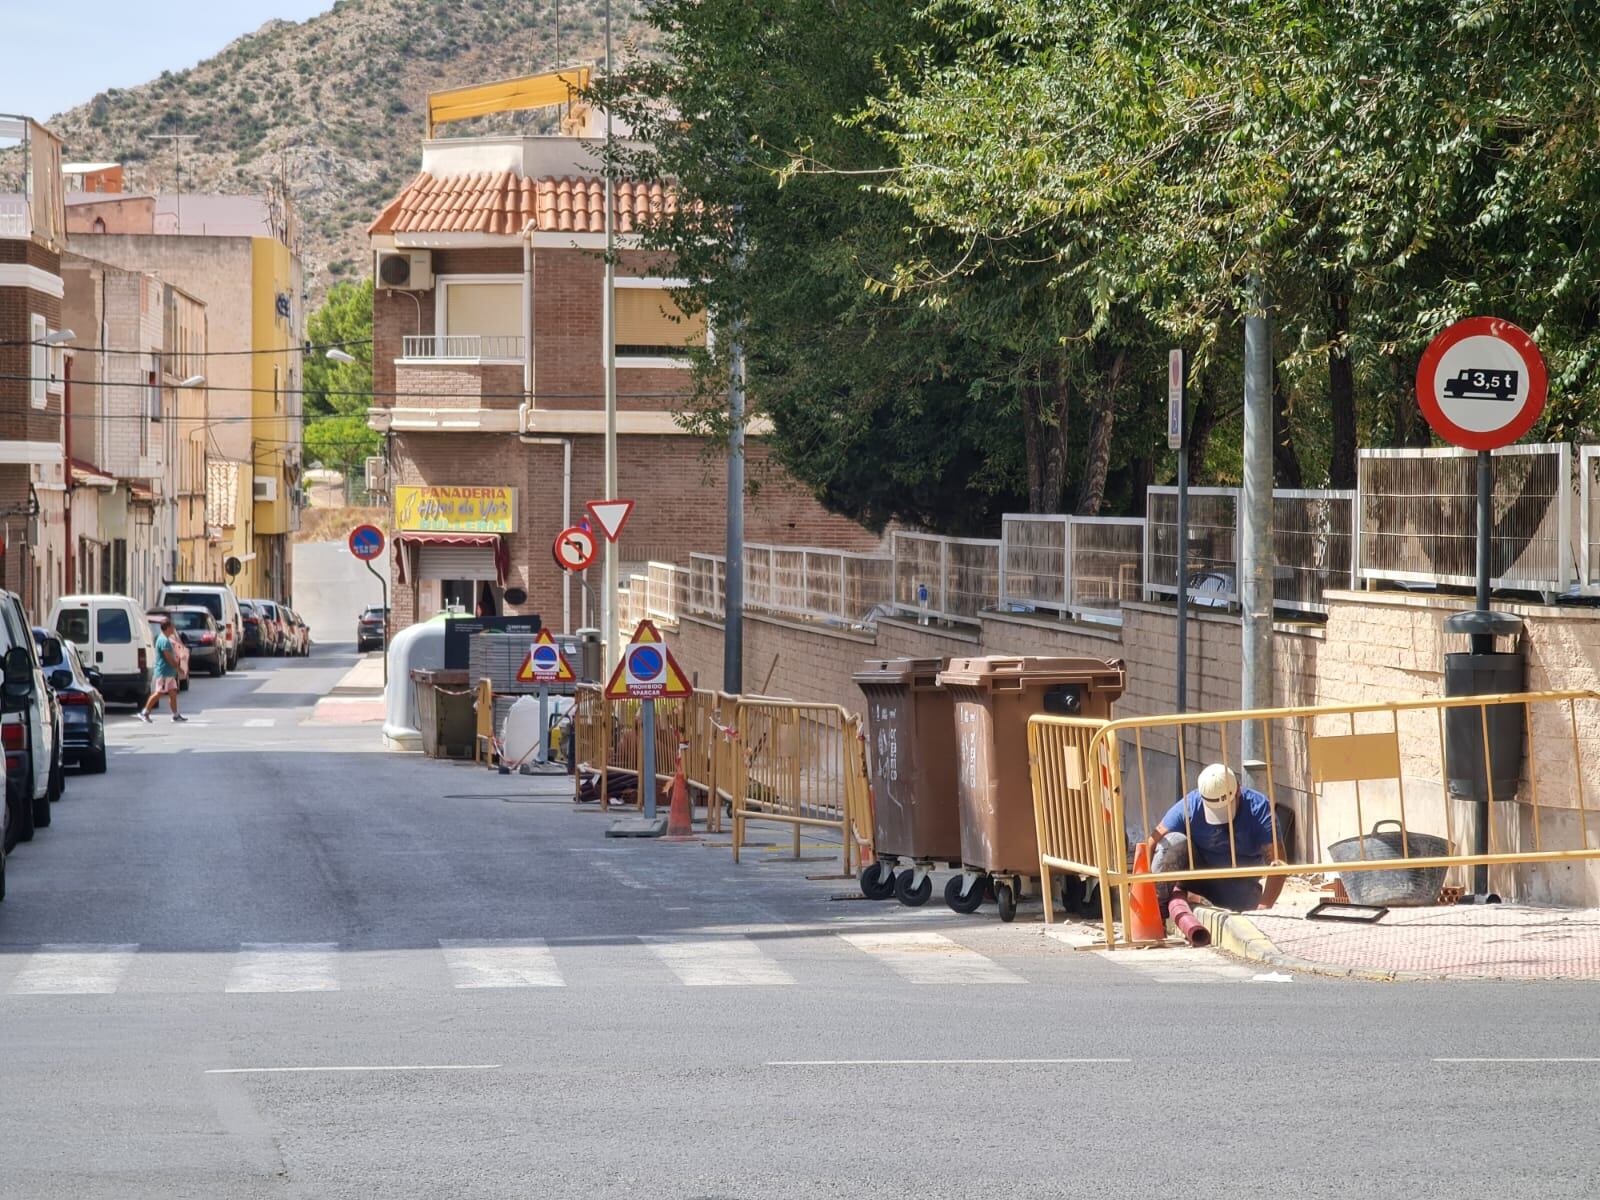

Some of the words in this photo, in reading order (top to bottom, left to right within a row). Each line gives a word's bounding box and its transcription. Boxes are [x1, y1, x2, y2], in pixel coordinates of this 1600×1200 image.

[1473, 372, 1500, 390] 3,5
[1504, 373, 1512, 388] t
[421, 487, 506, 499] PANADERIA
